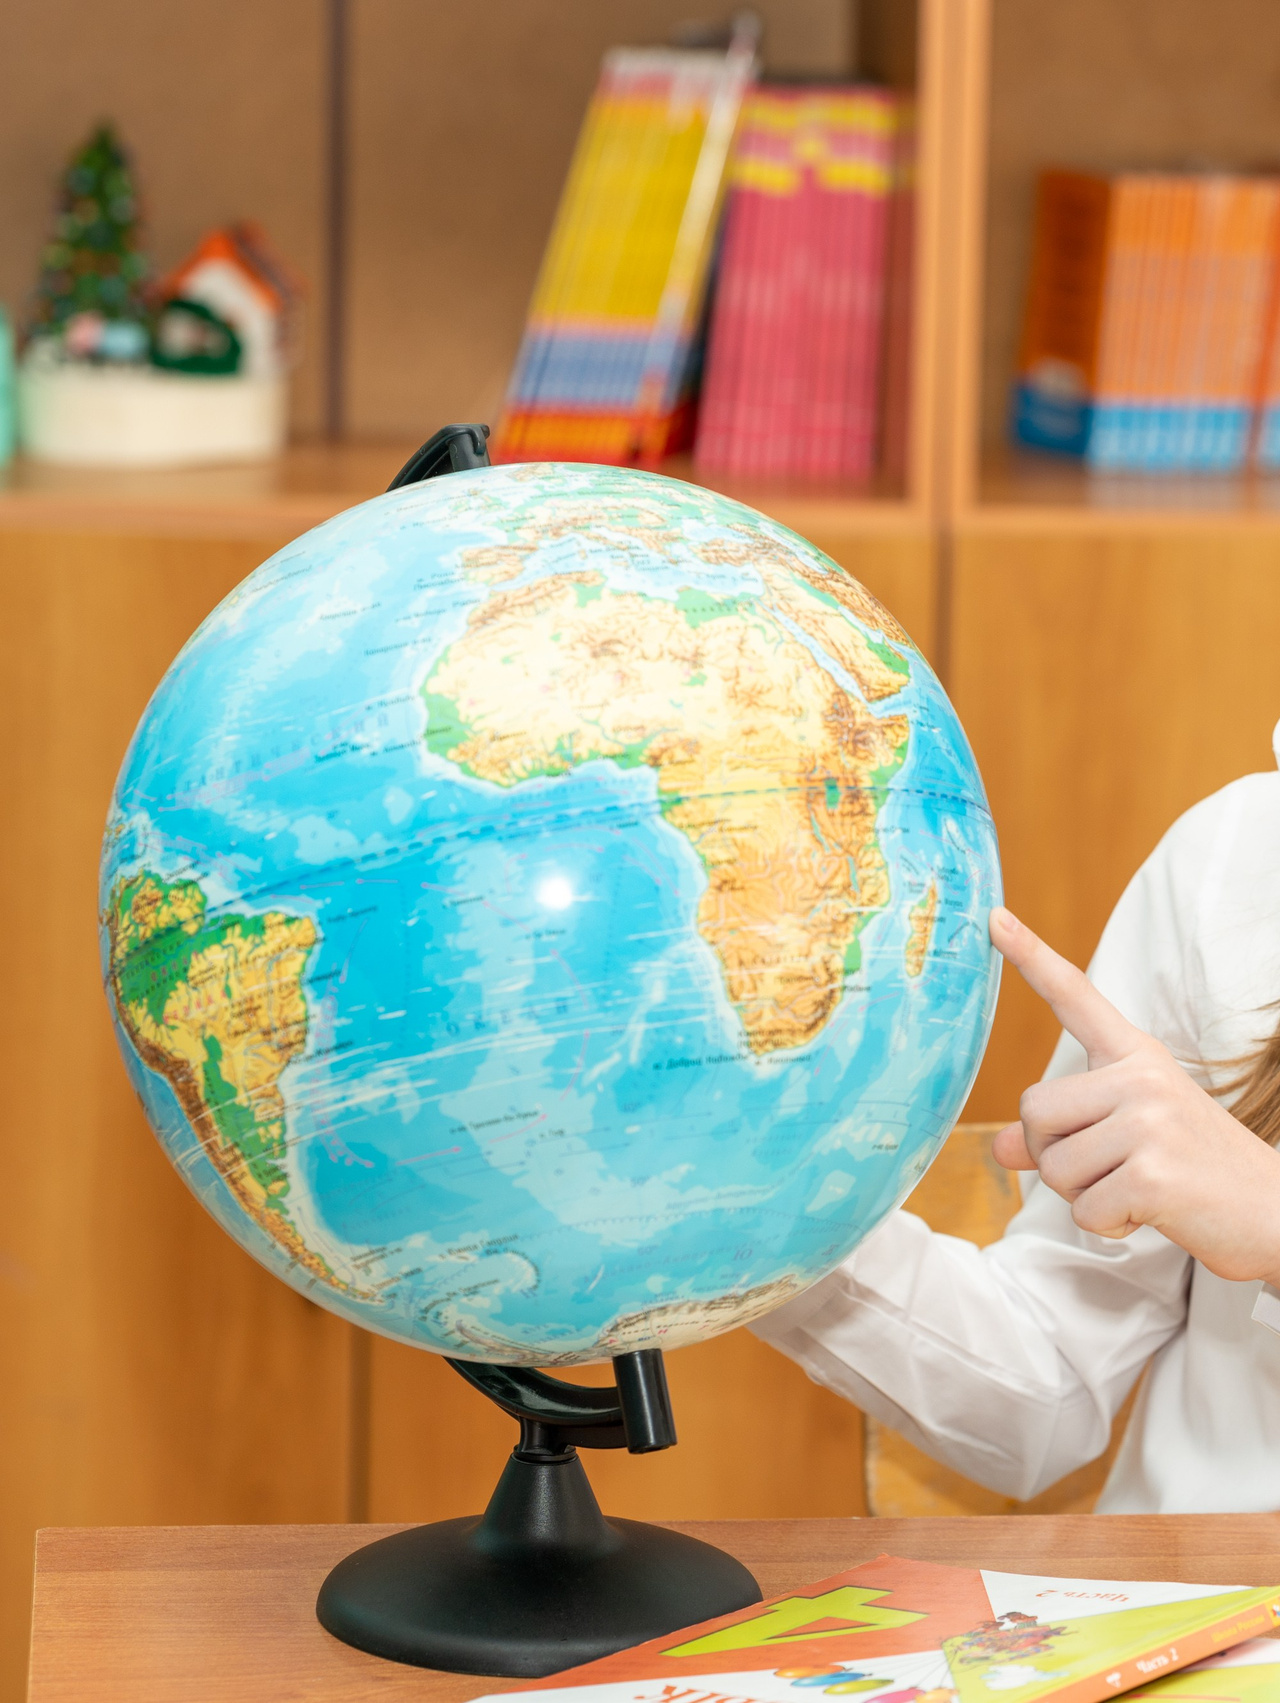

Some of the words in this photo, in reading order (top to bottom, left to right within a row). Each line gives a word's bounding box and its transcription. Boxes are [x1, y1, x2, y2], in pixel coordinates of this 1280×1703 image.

[1035, 1589, 1059, 1598] 2
[1063, 1591, 1130, 1602] Часть
[659, 1585, 930, 1658] 4
[1136, 1655, 1169, 1674] Часть
[1169, 1647, 1179, 1662] 2
